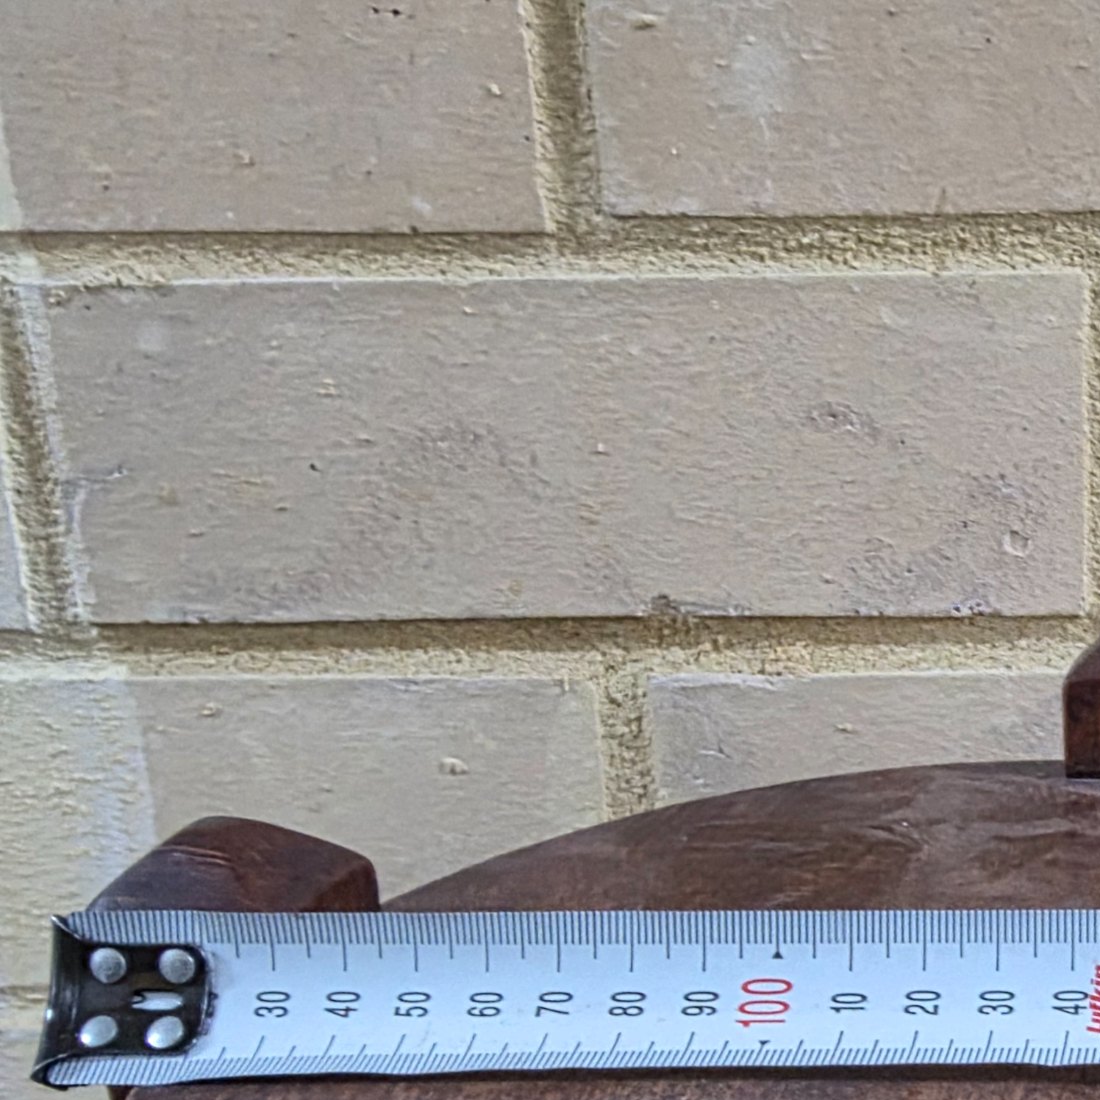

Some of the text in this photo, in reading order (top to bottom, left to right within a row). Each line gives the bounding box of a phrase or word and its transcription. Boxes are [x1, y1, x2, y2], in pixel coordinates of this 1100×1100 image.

[254, 991, 291, 1018] 30
[324, 991, 361, 1018] 40
[394, 992, 431, 1017] 50
[467, 992, 504, 1017] 60
[535, 992, 574, 1017] 70
[610, 991, 647, 1016] 80
[681, 991, 720, 1016] 90
[735, 978, 793, 1027] 100
[830, 993, 868, 1013] 10
[904, 990, 941, 1015] 20
[978, 990, 1015, 1015] 30
[1051, 990, 1089, 1015] 40
